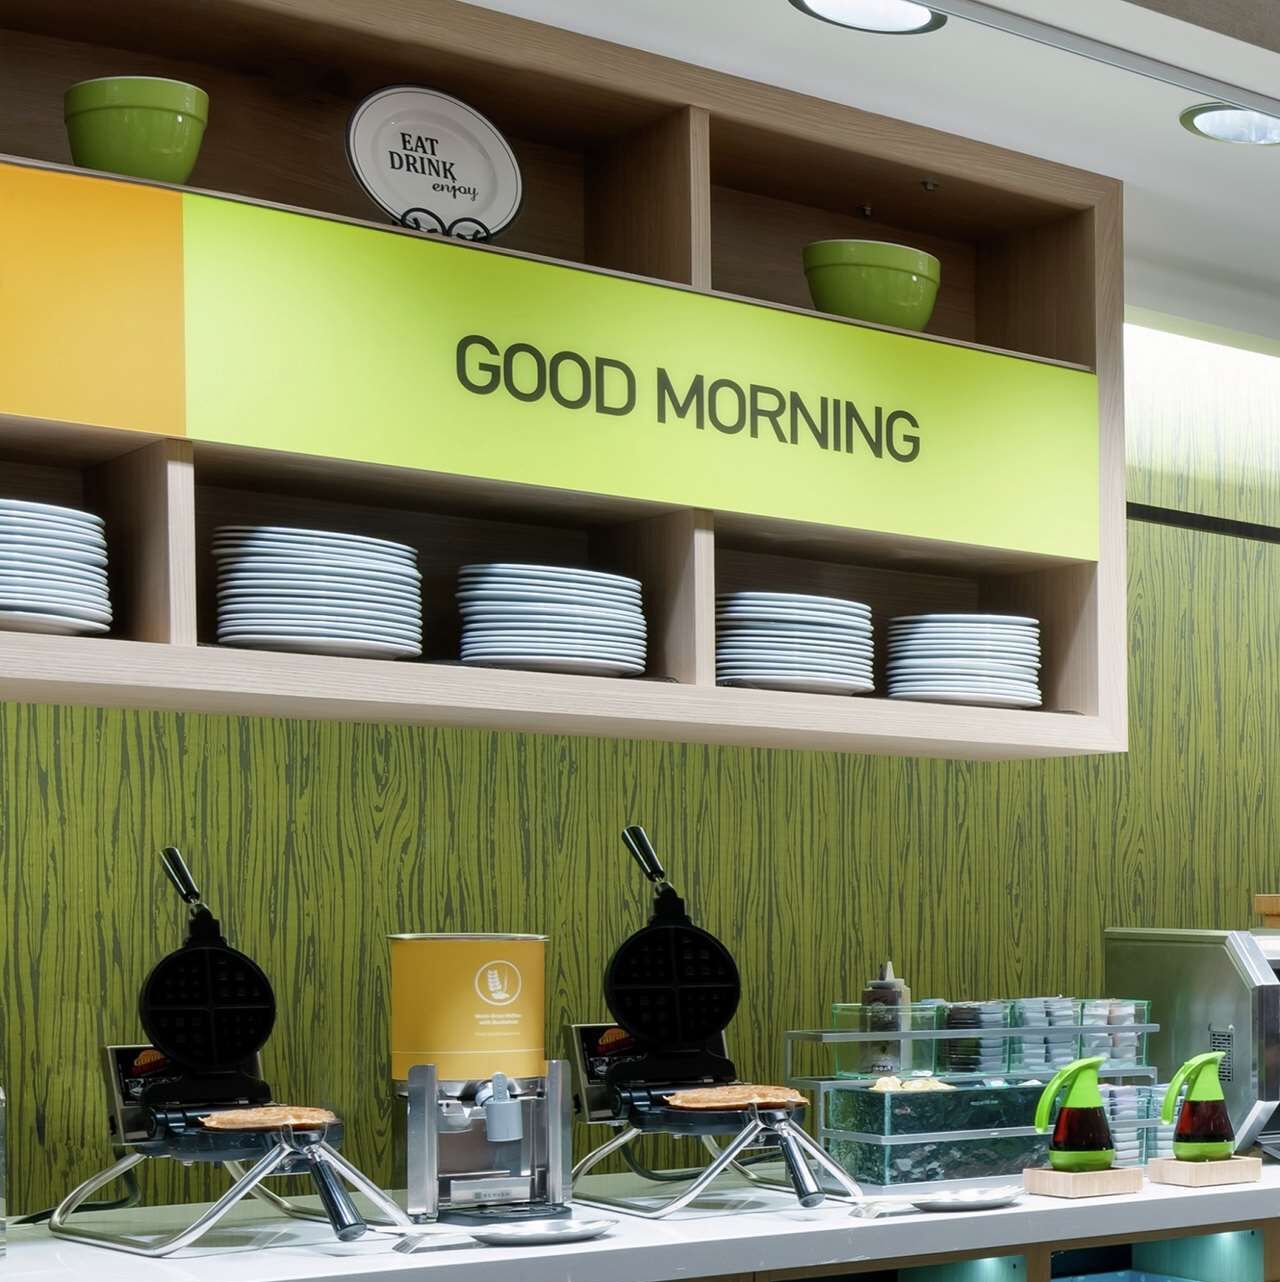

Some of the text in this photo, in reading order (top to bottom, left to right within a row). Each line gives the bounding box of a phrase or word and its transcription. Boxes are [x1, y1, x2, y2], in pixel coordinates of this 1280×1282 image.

[400, 132, 439, 156] EAT
[388, 150, 458, 181] DRINK
[431, 180, 479, 202] enjoy
[456, 334, 921, 463] GOOD MORNING
